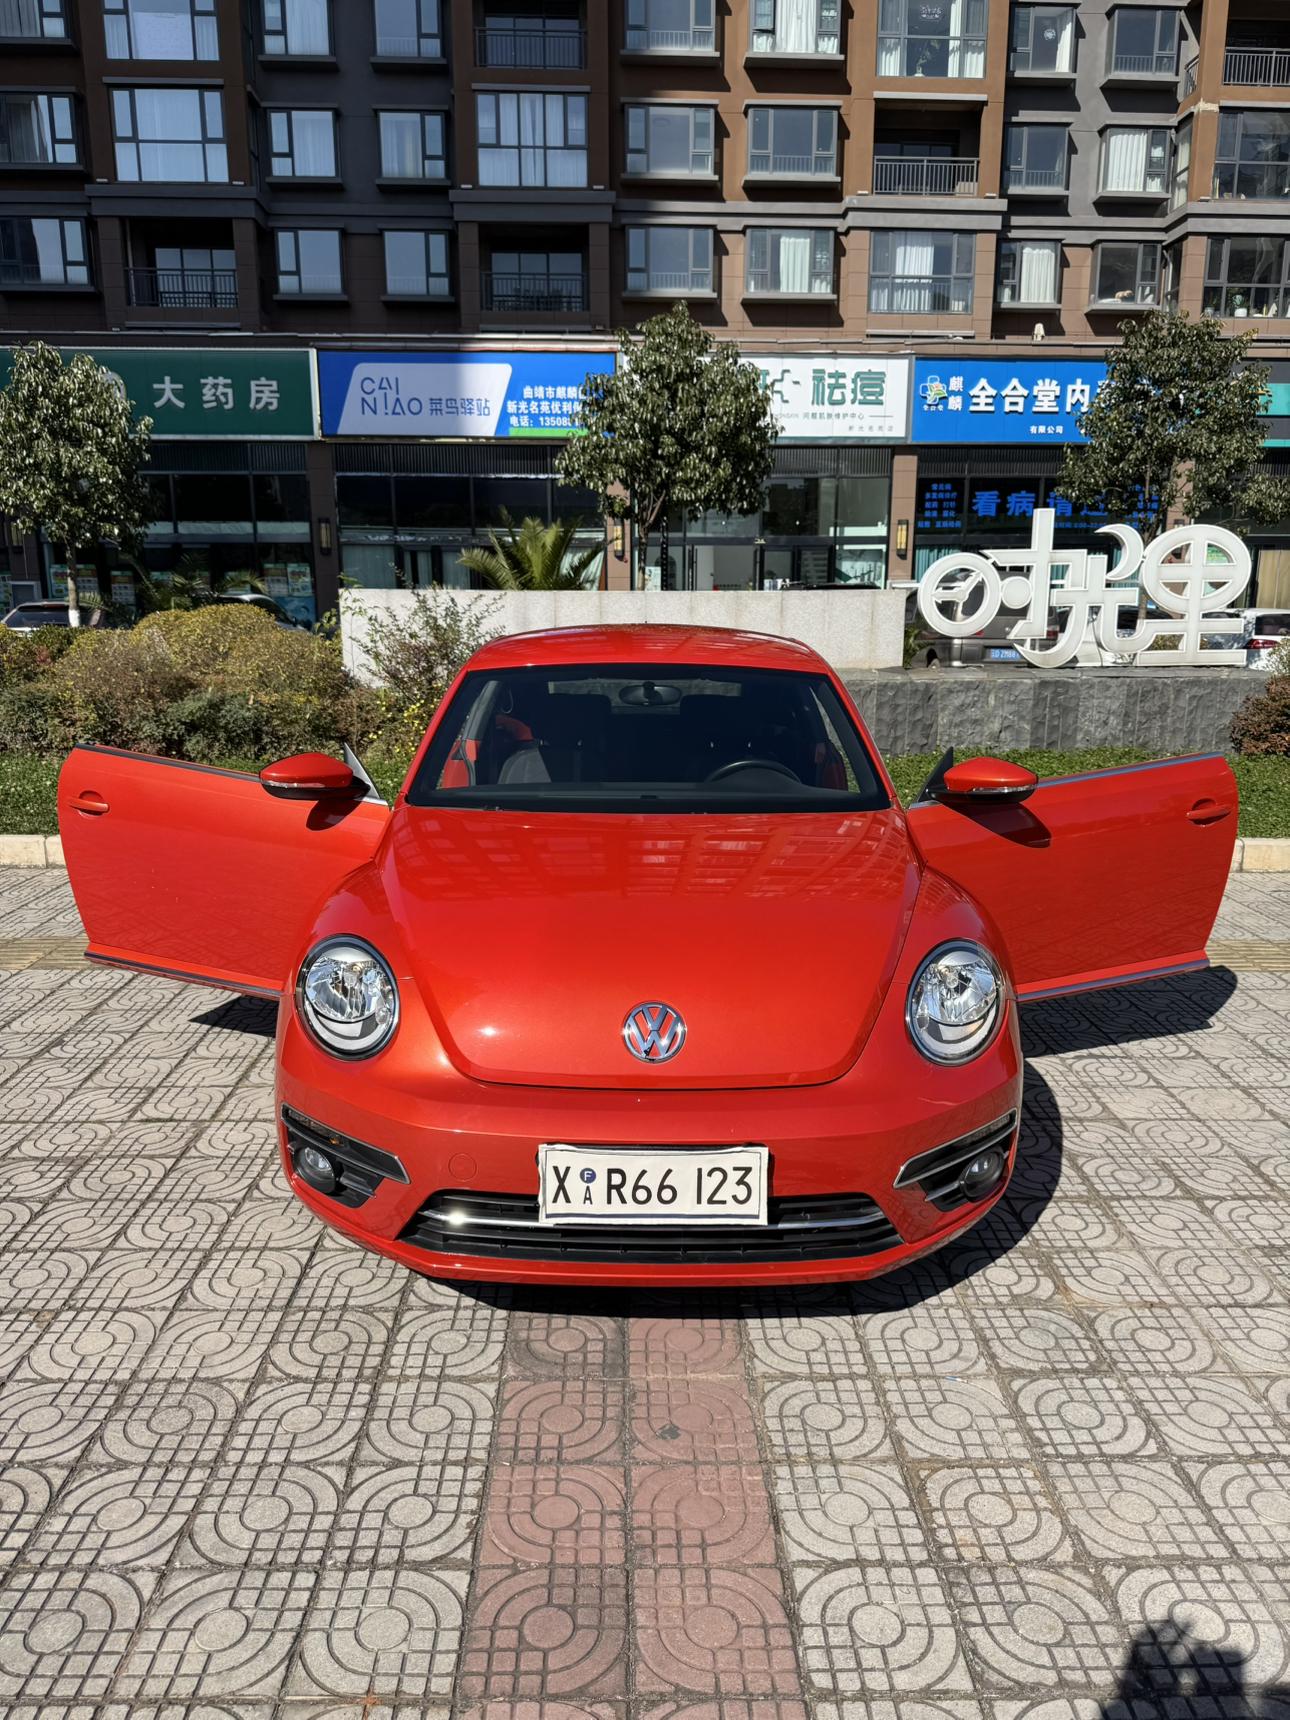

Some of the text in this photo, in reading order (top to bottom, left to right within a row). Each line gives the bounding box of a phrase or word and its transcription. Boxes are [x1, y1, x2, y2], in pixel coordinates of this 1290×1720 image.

[153, 376, 280, 411] 大药房
[360, 377, 400, 396] CAI
[811, 369, 887, 406] 祛痘
[948, 376, 963, 411] 麒麟
[429, 398, 491, 416] 菜鸟驿站
[1030, 425, 1064, 434] 有限公司
[606, 1168, 678, 1205] R66
[696, 1167, 753, 1205] 123
